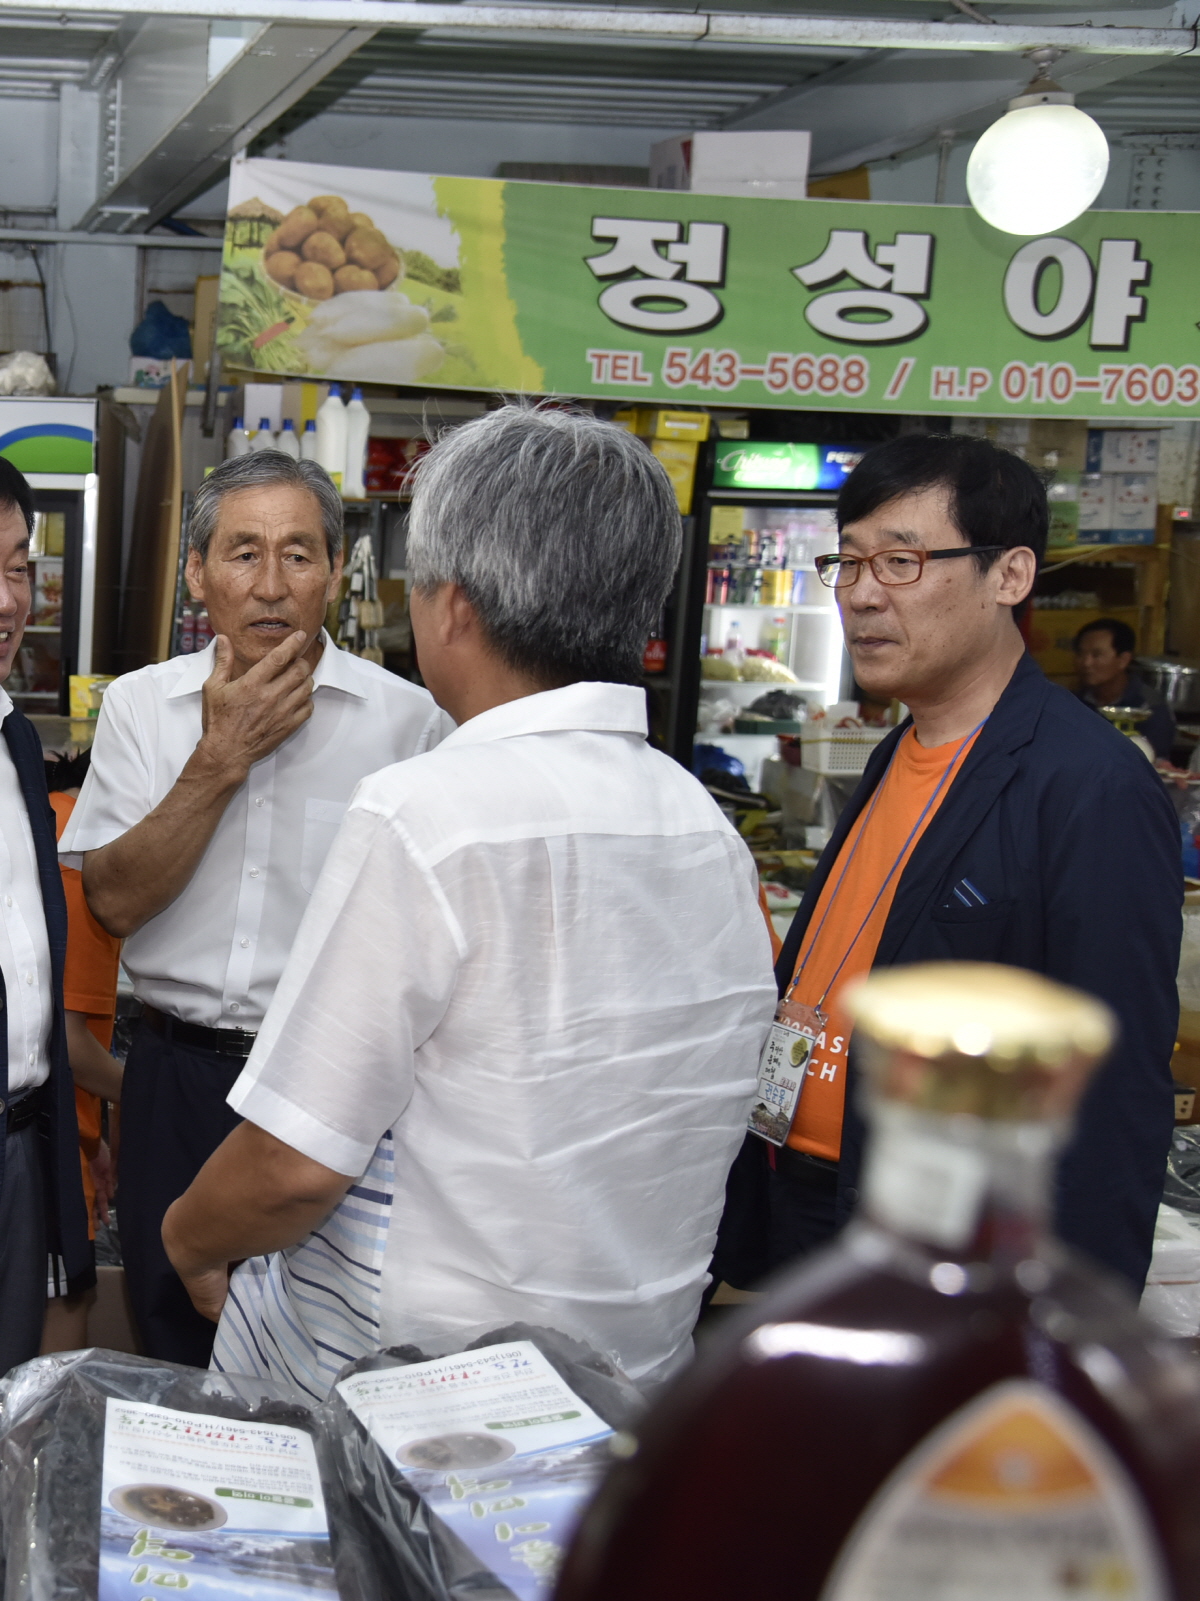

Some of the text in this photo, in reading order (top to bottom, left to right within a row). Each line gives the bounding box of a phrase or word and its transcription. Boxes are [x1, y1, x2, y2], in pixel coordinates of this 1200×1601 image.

[582, 216, 1200, 352] 정성야
[586, 348, 652, 386] TEL
[662, 346, 869, 395] 543-5688
[930, 366, 993, 401] H.P
[1001, 360, 1200, 407] 010-7603
